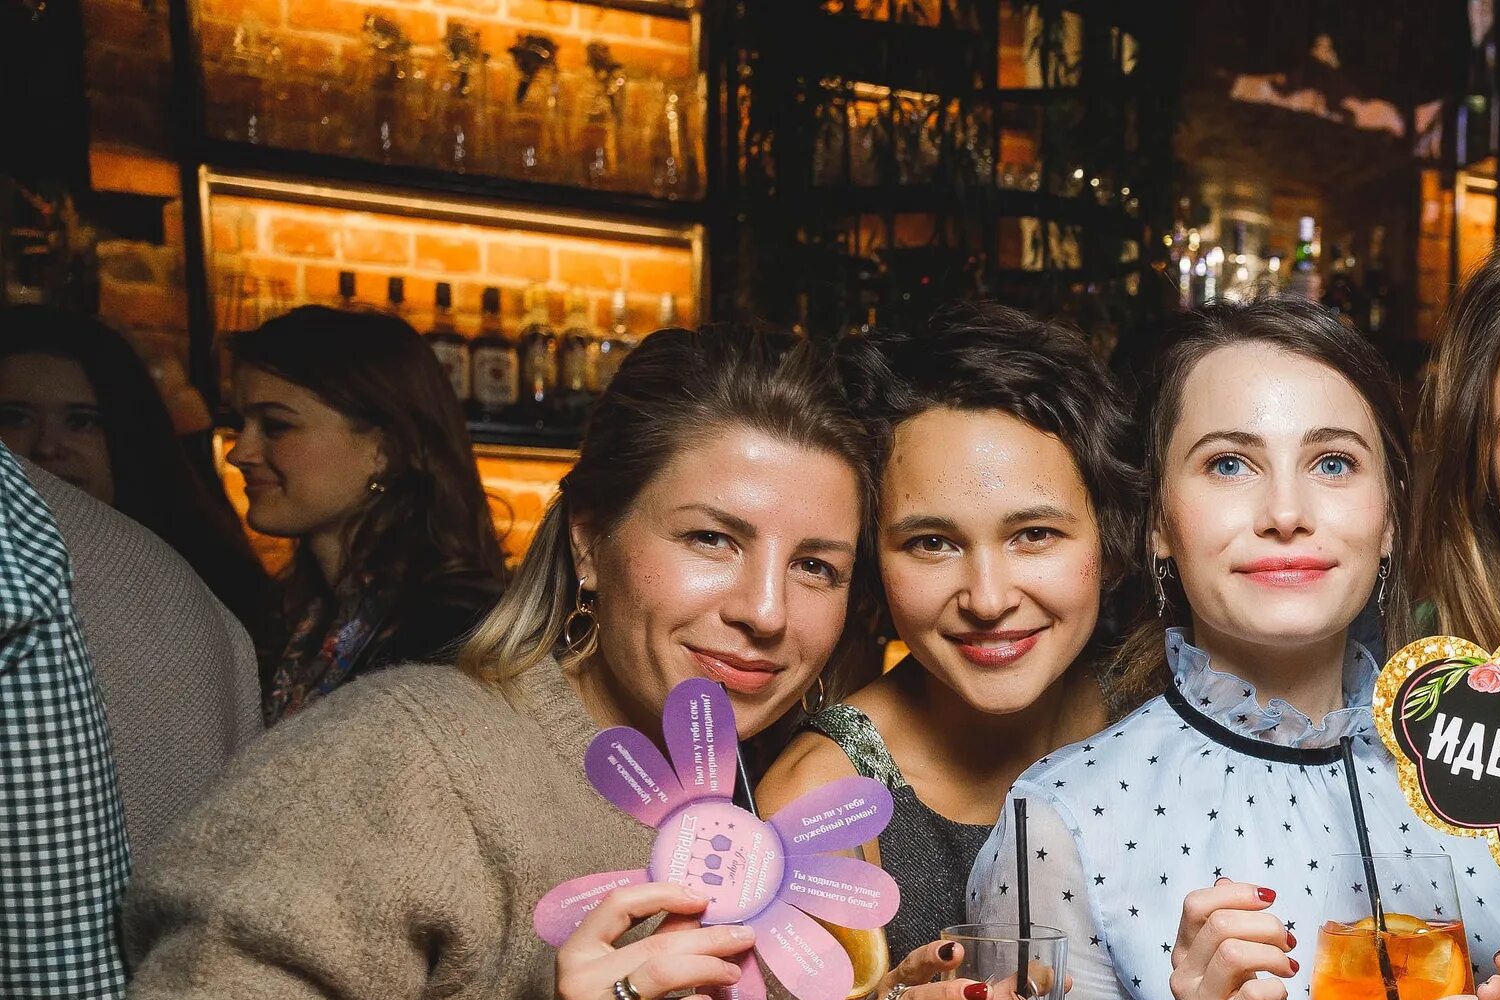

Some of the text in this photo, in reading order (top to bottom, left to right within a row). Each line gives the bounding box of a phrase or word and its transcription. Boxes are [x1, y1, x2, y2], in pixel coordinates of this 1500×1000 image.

[690, 699, 698, 720] секс
[691, 722, 700, 742] тебя
[701, 694, 718, 791] на первом свидании?
[695, 752, 703, 764] ли
[695, 766, 704, 785] Был
[793, 805, 877, 843] служебный роман?
[802, 798, 865, 826] Был ли у тебя
[754, 849, 775, 900] Ромашка
[793, 869, 881, 898] Ты ходила по улице
[560, 877, 630, 909] на раздевание?
[790, 882, 878, 909] без нижнего белья?
[777, 933, 794, 952] море
[792, 952, 817, 976] голая?
[785, 922, 825, 969] Ты купалась
